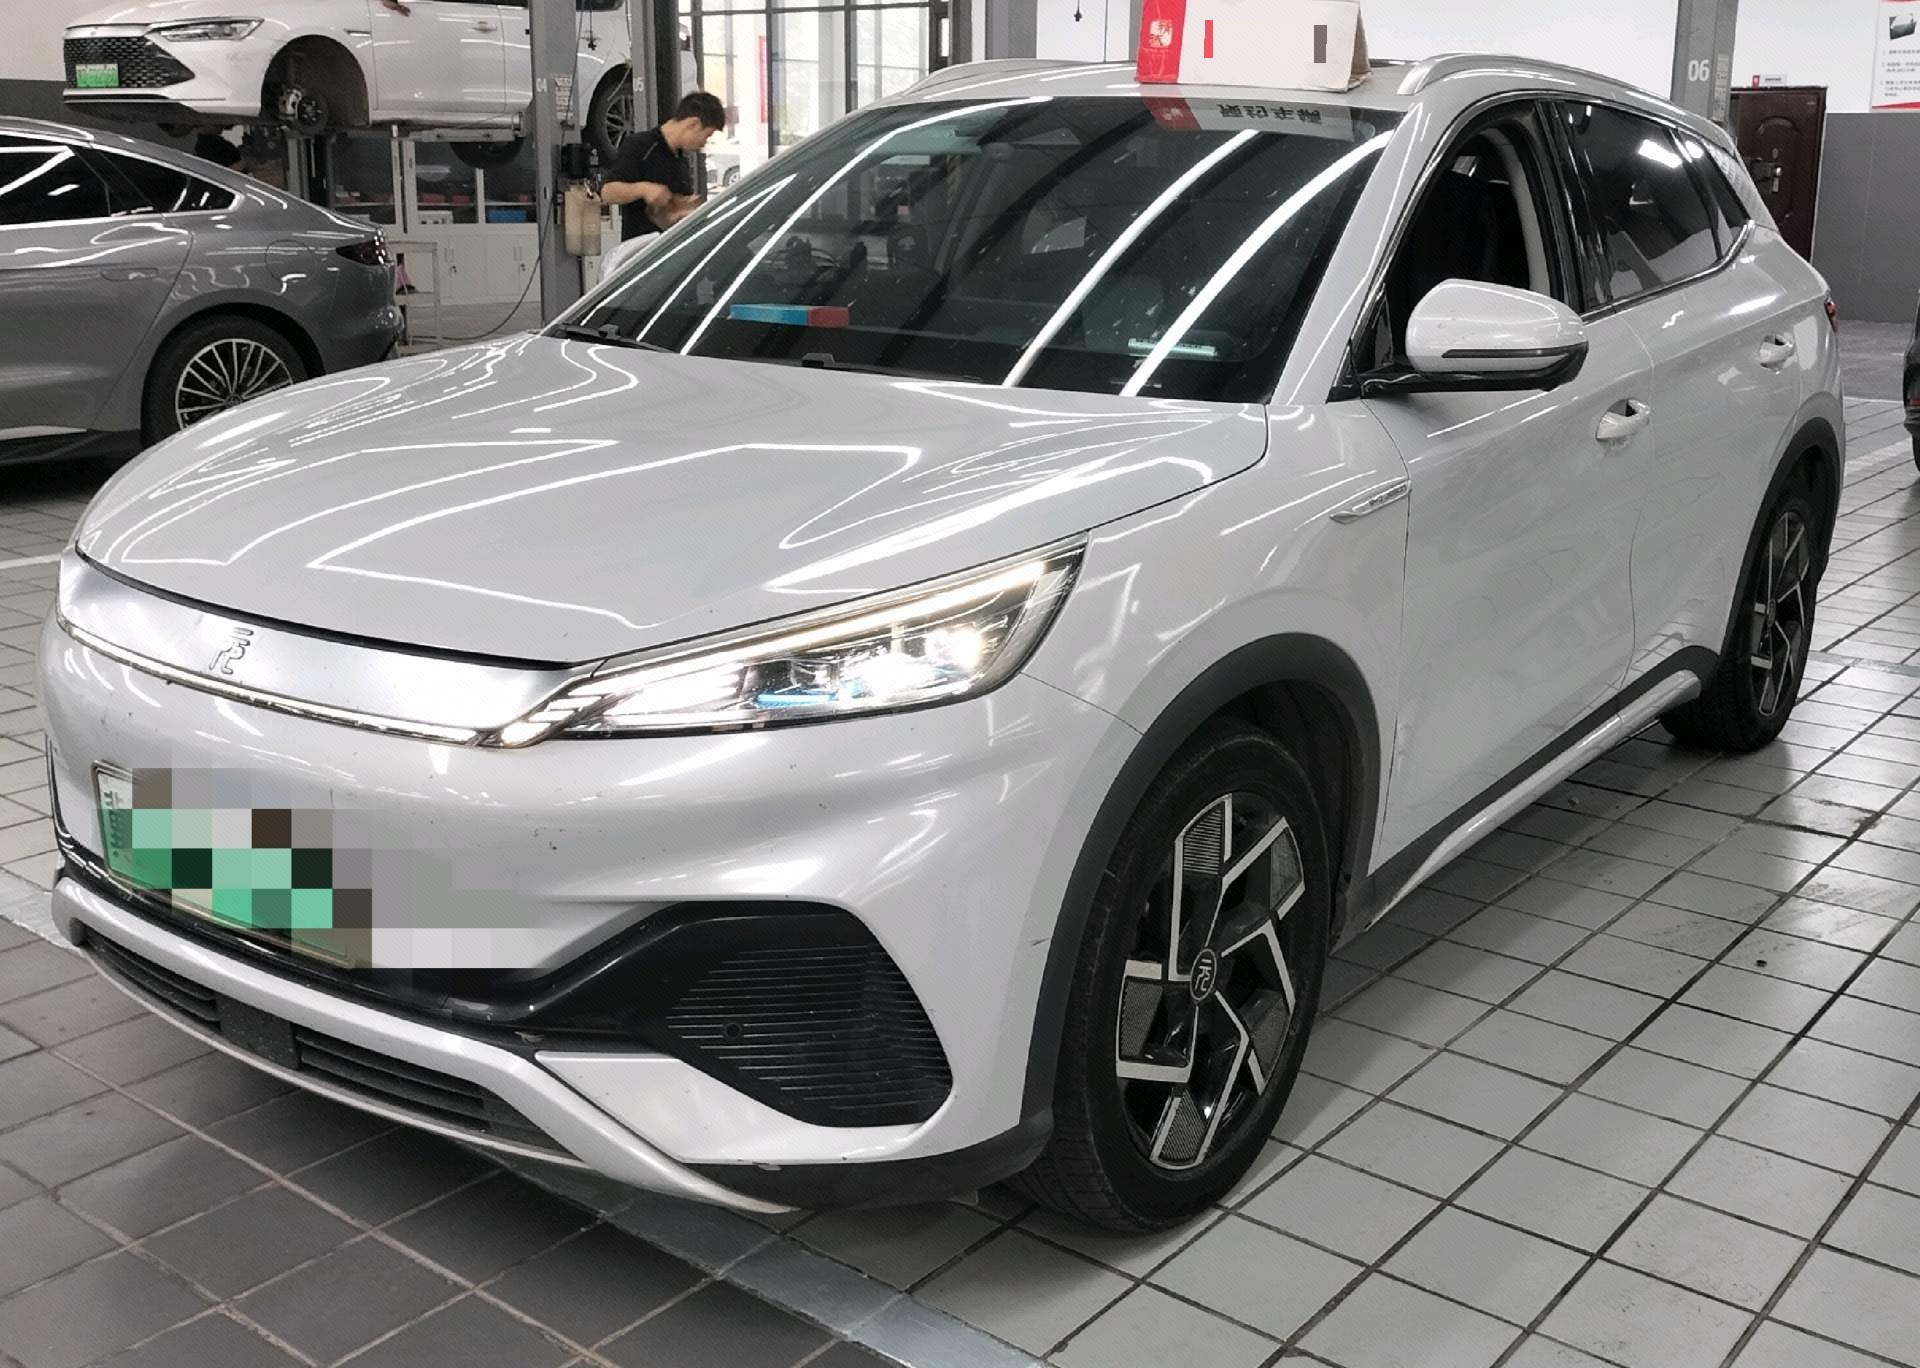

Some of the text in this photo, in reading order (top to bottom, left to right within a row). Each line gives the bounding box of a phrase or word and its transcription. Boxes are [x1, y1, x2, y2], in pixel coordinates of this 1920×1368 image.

[1688, 59, 1710, 82] 06
[536, 78, 547, 92] 04
[633, 77, 644, 92] 05
